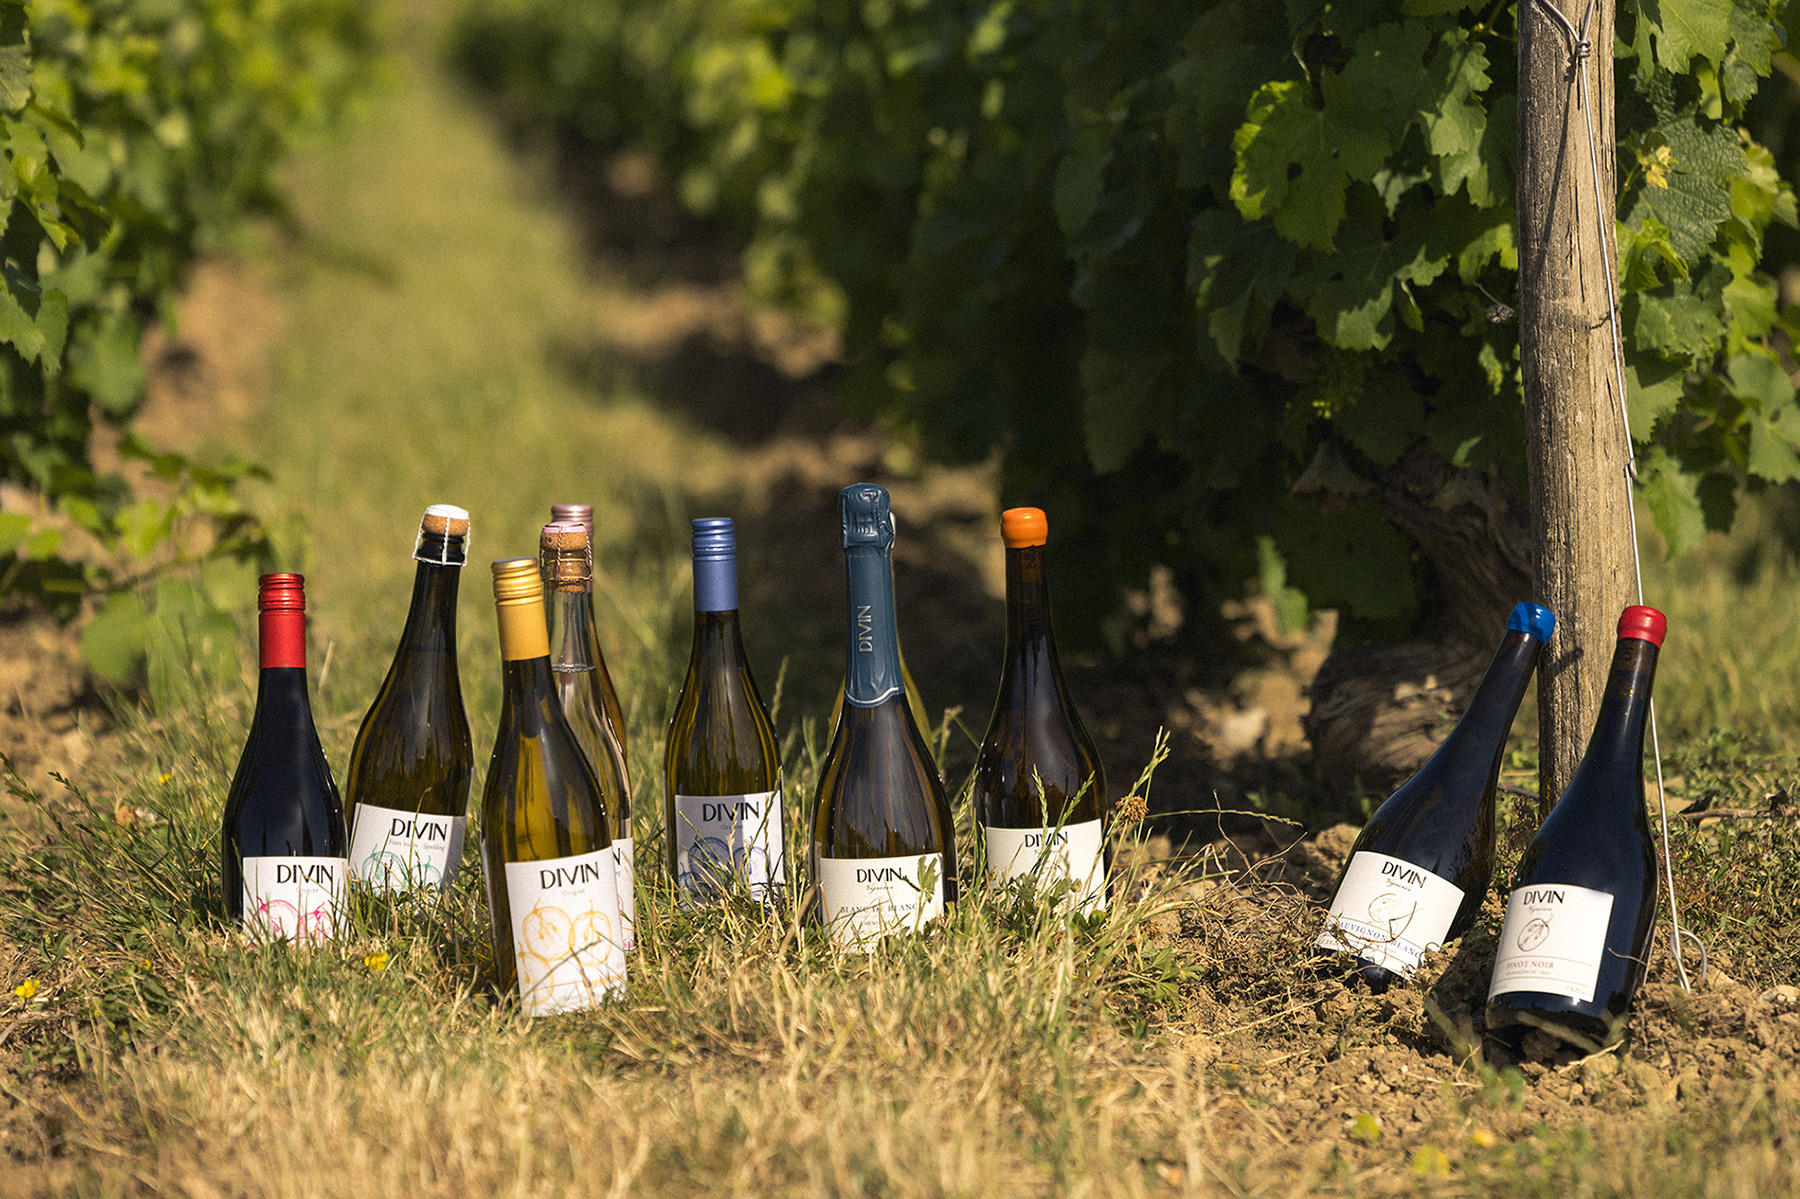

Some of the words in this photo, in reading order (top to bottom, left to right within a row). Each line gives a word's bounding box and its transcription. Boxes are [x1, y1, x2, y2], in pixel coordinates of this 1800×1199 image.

[857, 605, 873, 652] DIVIN
[702, 801, 760, 822] DIVIN
[391, 818, 447, 841] DIVIN
[1024, 831, 1069, 848] DIVIN
[277, 864, 334, 884] DIVIN
[540, 861, 600, 890] DIVIN
[857, 867, 902, 883] DIVIN
[1381, 861, 1427, 889] DIVIN
[888, 902, 921, 912] BLANC
[1523, 890, 1566, 906] DIVIN
[1334, 921, 1389, 942] AUVIGNON
[1506, 961, 1529, 970] PINOT
[1531, 961, 1555, 969] NOIR
